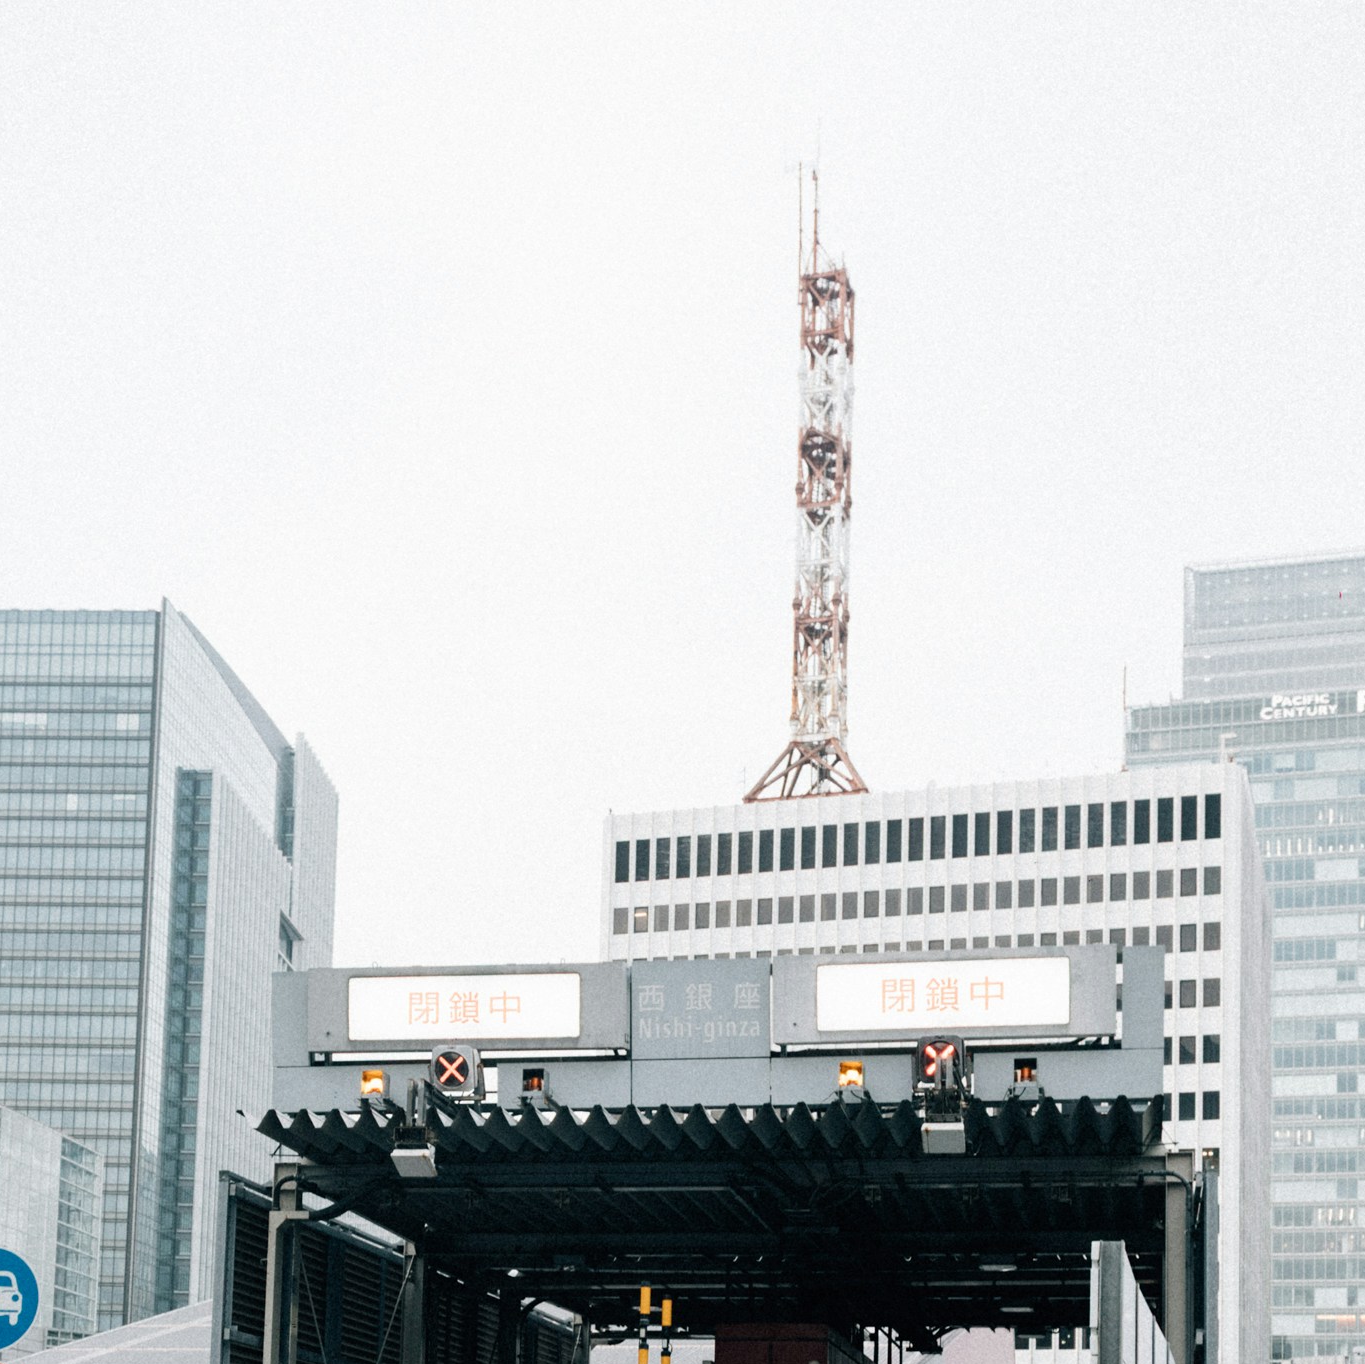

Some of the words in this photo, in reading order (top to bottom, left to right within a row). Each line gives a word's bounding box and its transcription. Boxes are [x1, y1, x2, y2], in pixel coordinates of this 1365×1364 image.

[1260, 704, 1338, 720] CENTURY
[1271, 693, 1330, 707] PACIFIC
[408, 990, 521, 1025] 閉鎖中
[638, 982, 761, 1012] 西銀座
[881, 976, 1005, 1013] 閉鎖中
[639, 1015, 761, 1043] Nishi-ginza
